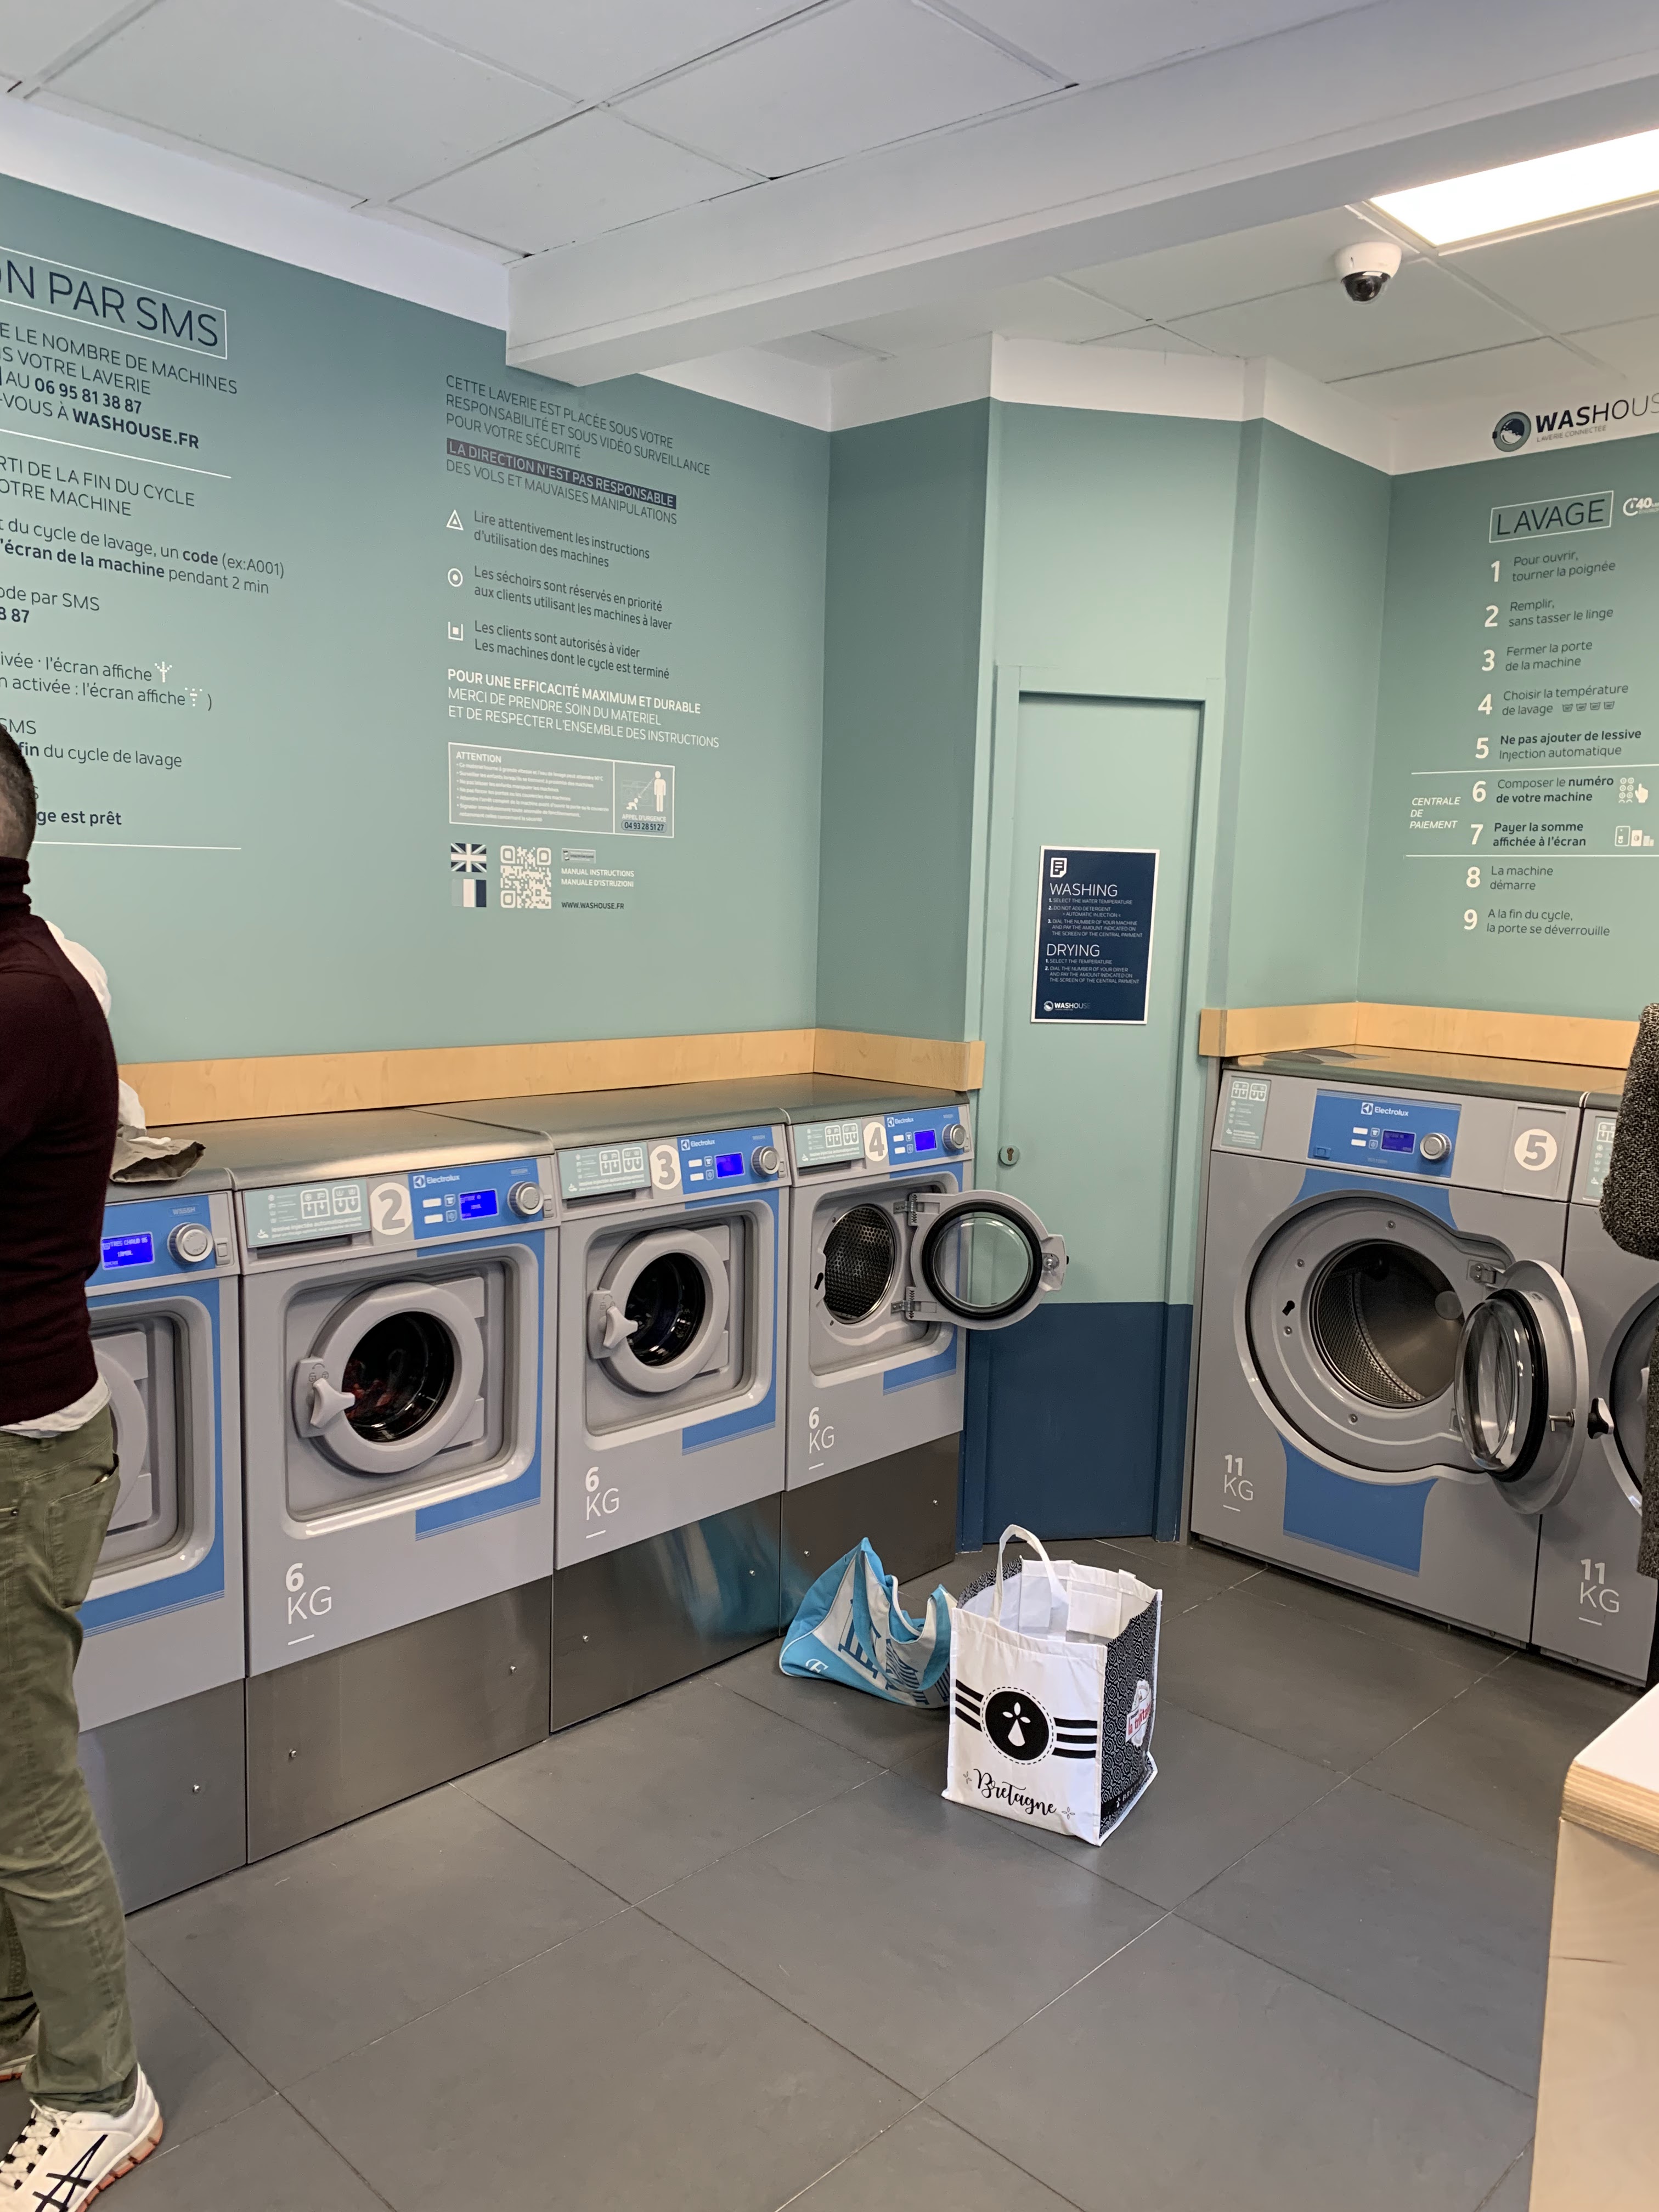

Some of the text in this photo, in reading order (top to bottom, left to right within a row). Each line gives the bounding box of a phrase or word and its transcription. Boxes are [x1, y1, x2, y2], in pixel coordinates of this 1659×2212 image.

[49, 271, 126, 323] PAR
[137, 297, 218, 347] SMS
[15, 326, 37, 346] LE
[42, 332, 121, 367] NOMBRE
[126, 354, 148, 373] DE
[152, 360, 237, 394] MACHINES
[17, 349, 77, 377] VOTRE
[81, 365, 151, 397] LAVERIE
[5, 371, 142, 414] AU 06 95 81 38 87
[57, 400, 69, 421] À
[72, 408, 199, 449] WASHOUSE.FR
[446, 375, 673, 449] CETTE LAVERIE EST PLACÉE SOUS VOTRE
[446, 393, 710, 476] RESPONSABILITÉ ET SOUS VIDÉO SURVEILLANCE
[446, 413, 582, 459] POUR VOTRE SÉCURITÉ
[1537, 425, 1606, 442] LAVERIE CONNECTÉE
[28, 461, 52, 479] DE
[57, 467, 79, 484] LA
[83, 472, 111, 490] FIN
[115, 478, 139, 496] DU
[143, 484, 195, 507] CYCLE
[449, 441, 675, 509] LA DIRECTION N'EST PAS RESPONSABLE
[50, 487, 131, 516] MACHINE
[447, 459, 677, 524] DES VOLS ET MAUVAISES MANIPULATIONS
[1497, 499, 1605, 535] LAVAGE
[8, 518, 284, 581] du cycle de lavage, un code (ex:A001)
[473, 529, 609, 567] d'utilisation des machines
[474, 510, 650, 560] Lire attentivement les instructions
[57, 549, 269, 594] de la machine pendant 2 min
[1491, 551, 1578, 582] 1 Pour ouvrir,
[1512, 561, 1616, 582] tourner la poignée
[1485, 599, 1554, 628] 2 Remplir,
[448, 668, 701, 714] POUR UNE EFFICACITÉ MAXIMUM ET DURABLE
[43, 744, 64, 758] du
[67, 747, 109, 764] cycle
[113, 749, 131, 763] de
[136, 751, 182, 770] lavage
[456, 751, 501, 763] ATTENTION
[1475, 729, 1641, 759] 5 Ne pas ajouter de lessive
[1499, 746, 1622, 762] Injection automatique
[1410, 809, 1424, 817] DE
[1412, 797, 1462, 806] CENTRALE
[61, 810, 122, 827] est prêt
[1409, 820, 1458, 829] PAIEMENT
[1470, 822, 1583, 845] 7 Payer la somme
[589, 869, 635, 877] INSTRUCTIONS
[1049, 883, 1118, 897] WASHING
[561, 901, 624, 910] WWW.WASHOUSE.FR
[1047, 943, 1100, 957] DRYING
[1374, 1106, 1409, 1116] Electrolux
[690, 1139, 715, 1147] Electrolux
[869, 1127, 884, 1156] 4
[1524, 1135, 1550, 1165] 5
[426, 1175, 460, 1184] Electrolux
[658, 1150, 675, 1185] 3
[381, 1189, 405, 1230] 2
[809, 1407, 820, 1429] 6
[809, 1426, 834, 1454] KG
[585, 1466, 600, 1492] 6
[1224, 1454, 1243, 1476] 11
[1224, 1475, 1254, 1501] KG
[586, 1487, 619, 1521] KG
[285, 1562, 304, 1592] 6
[1581, 1559, 1605, 1584] 11
[288, 1585, 332, 1625] KG
[1580, 1582, 1620, 1613] KG
[973, 1768, 1057, 1816] Bretagne
